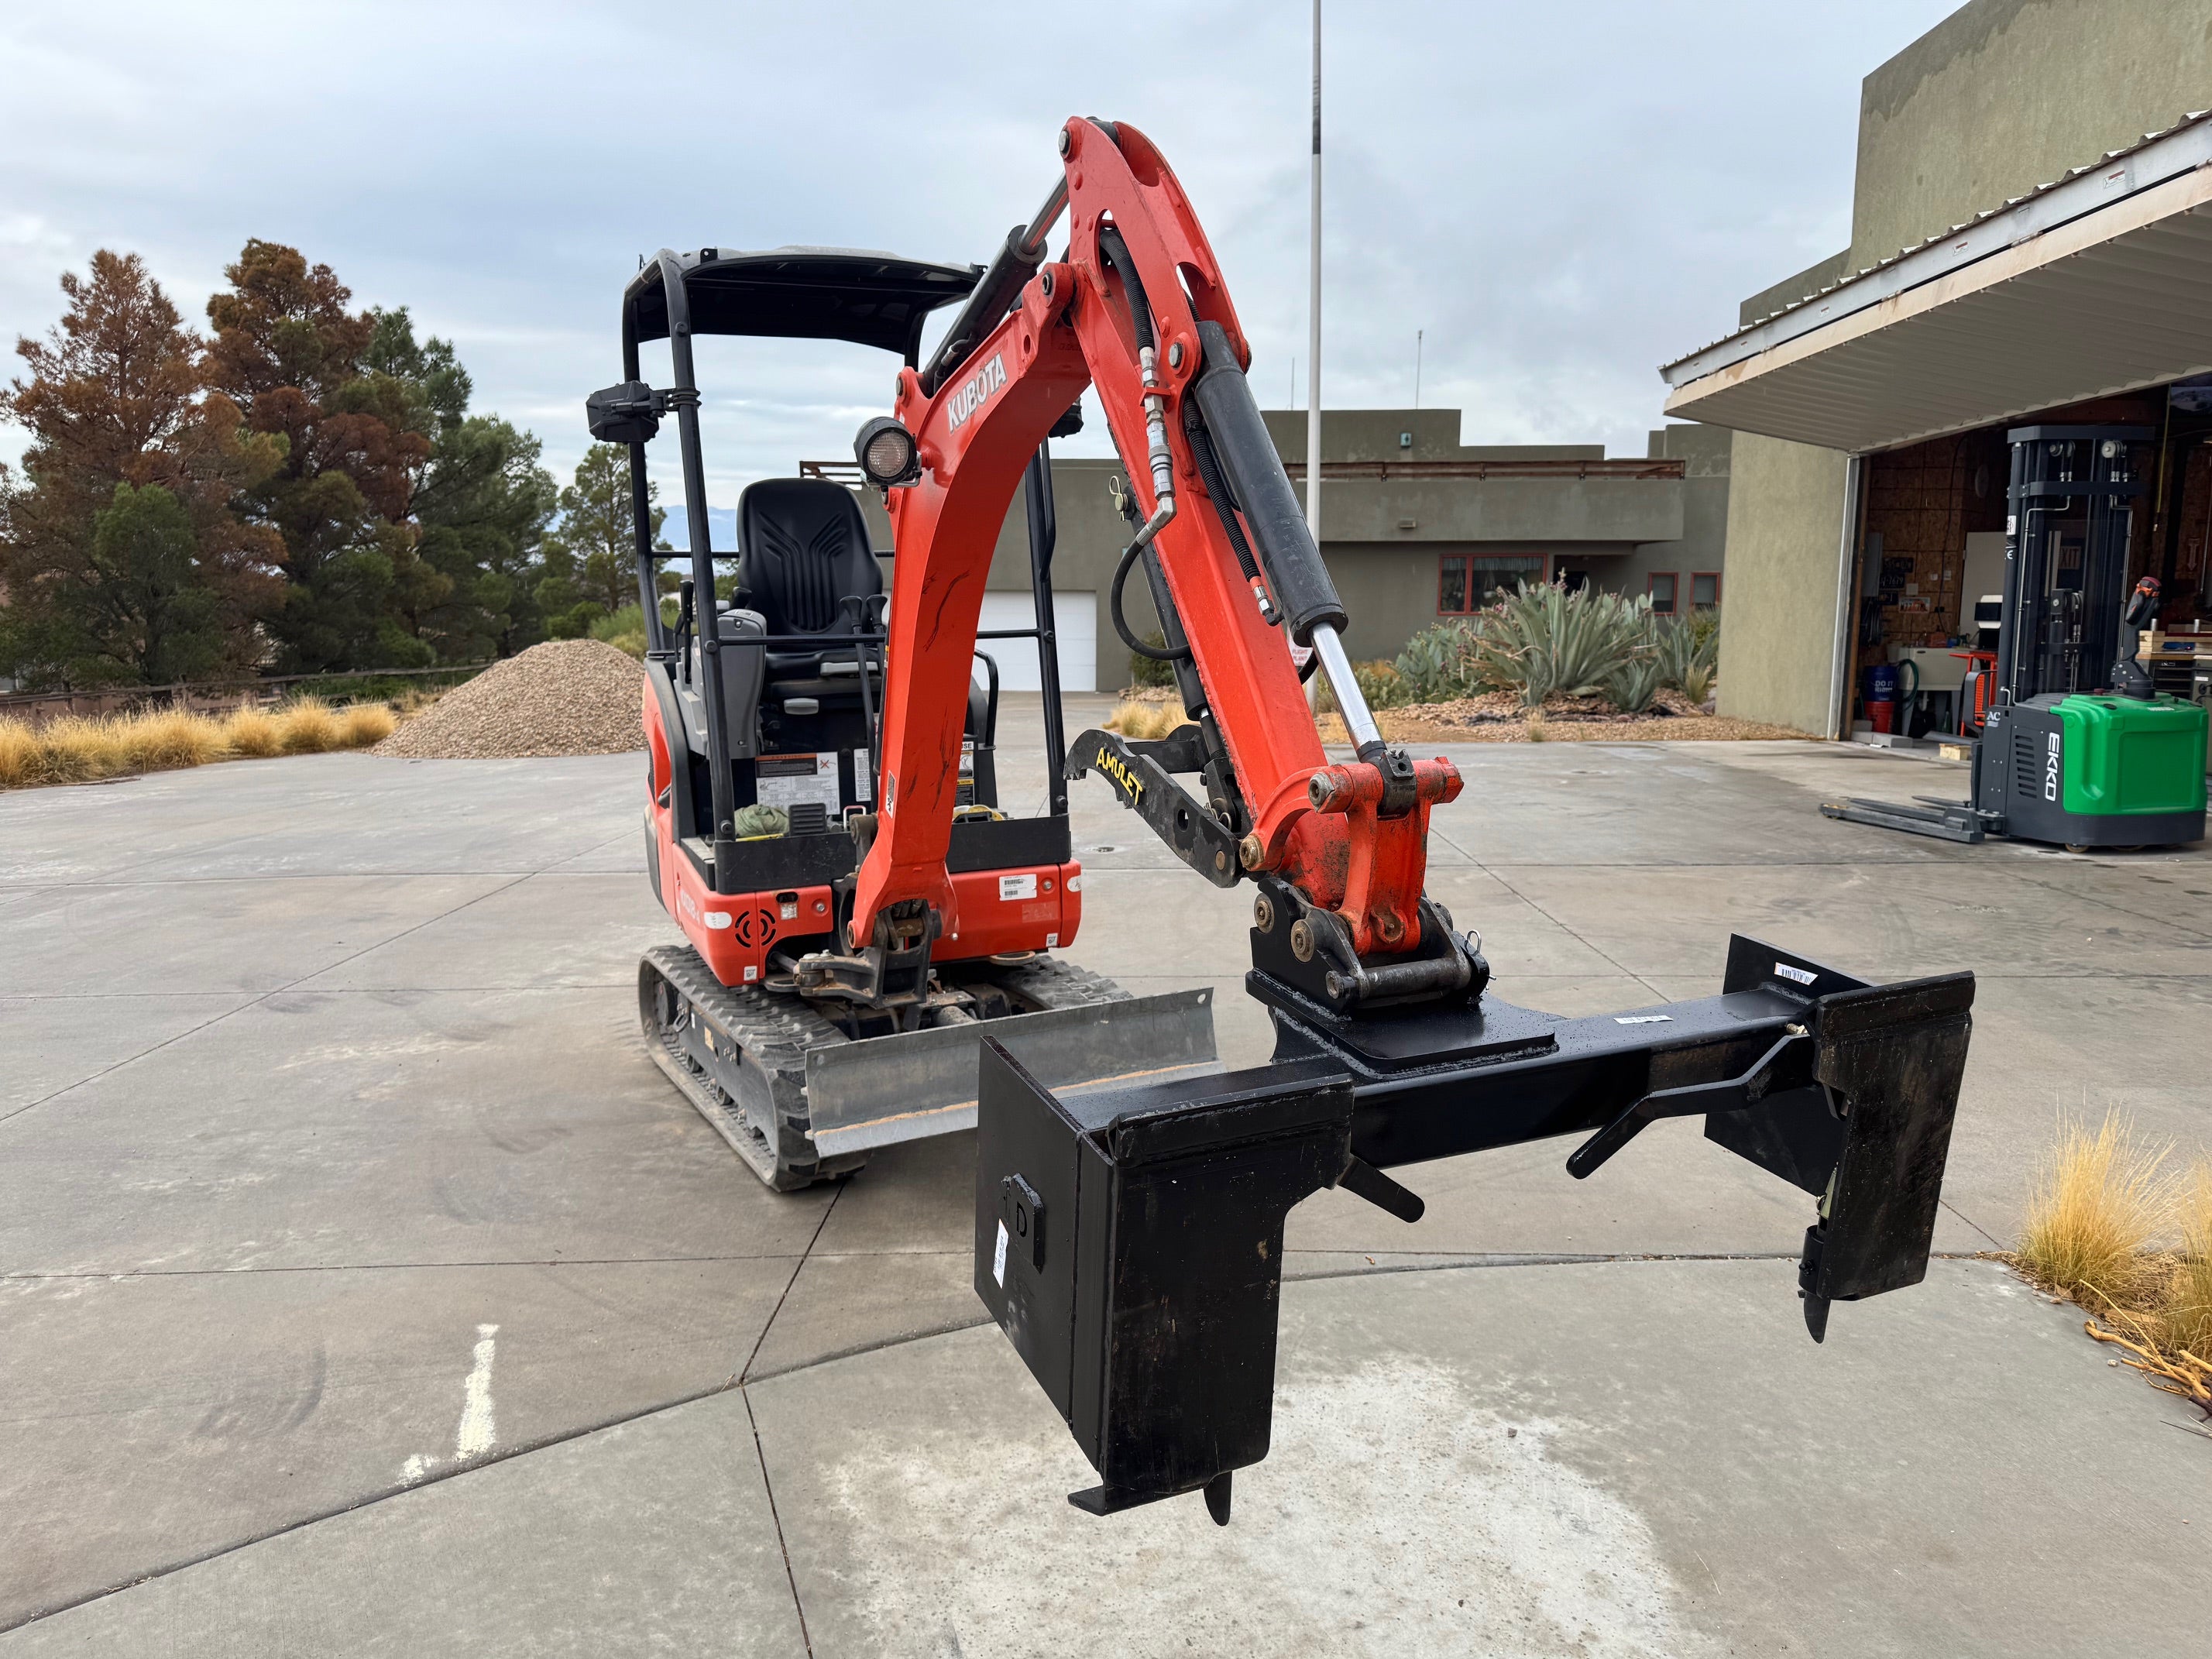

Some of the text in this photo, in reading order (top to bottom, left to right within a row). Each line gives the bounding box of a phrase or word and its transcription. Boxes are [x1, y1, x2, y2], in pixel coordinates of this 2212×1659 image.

[947, 352, 1008, 434] KUBOTA
[1987, 711, 2001, 721] AC
[1096, 747, 1143, 805] AMULET
[2045, 732, 2060, 802] EKKO
